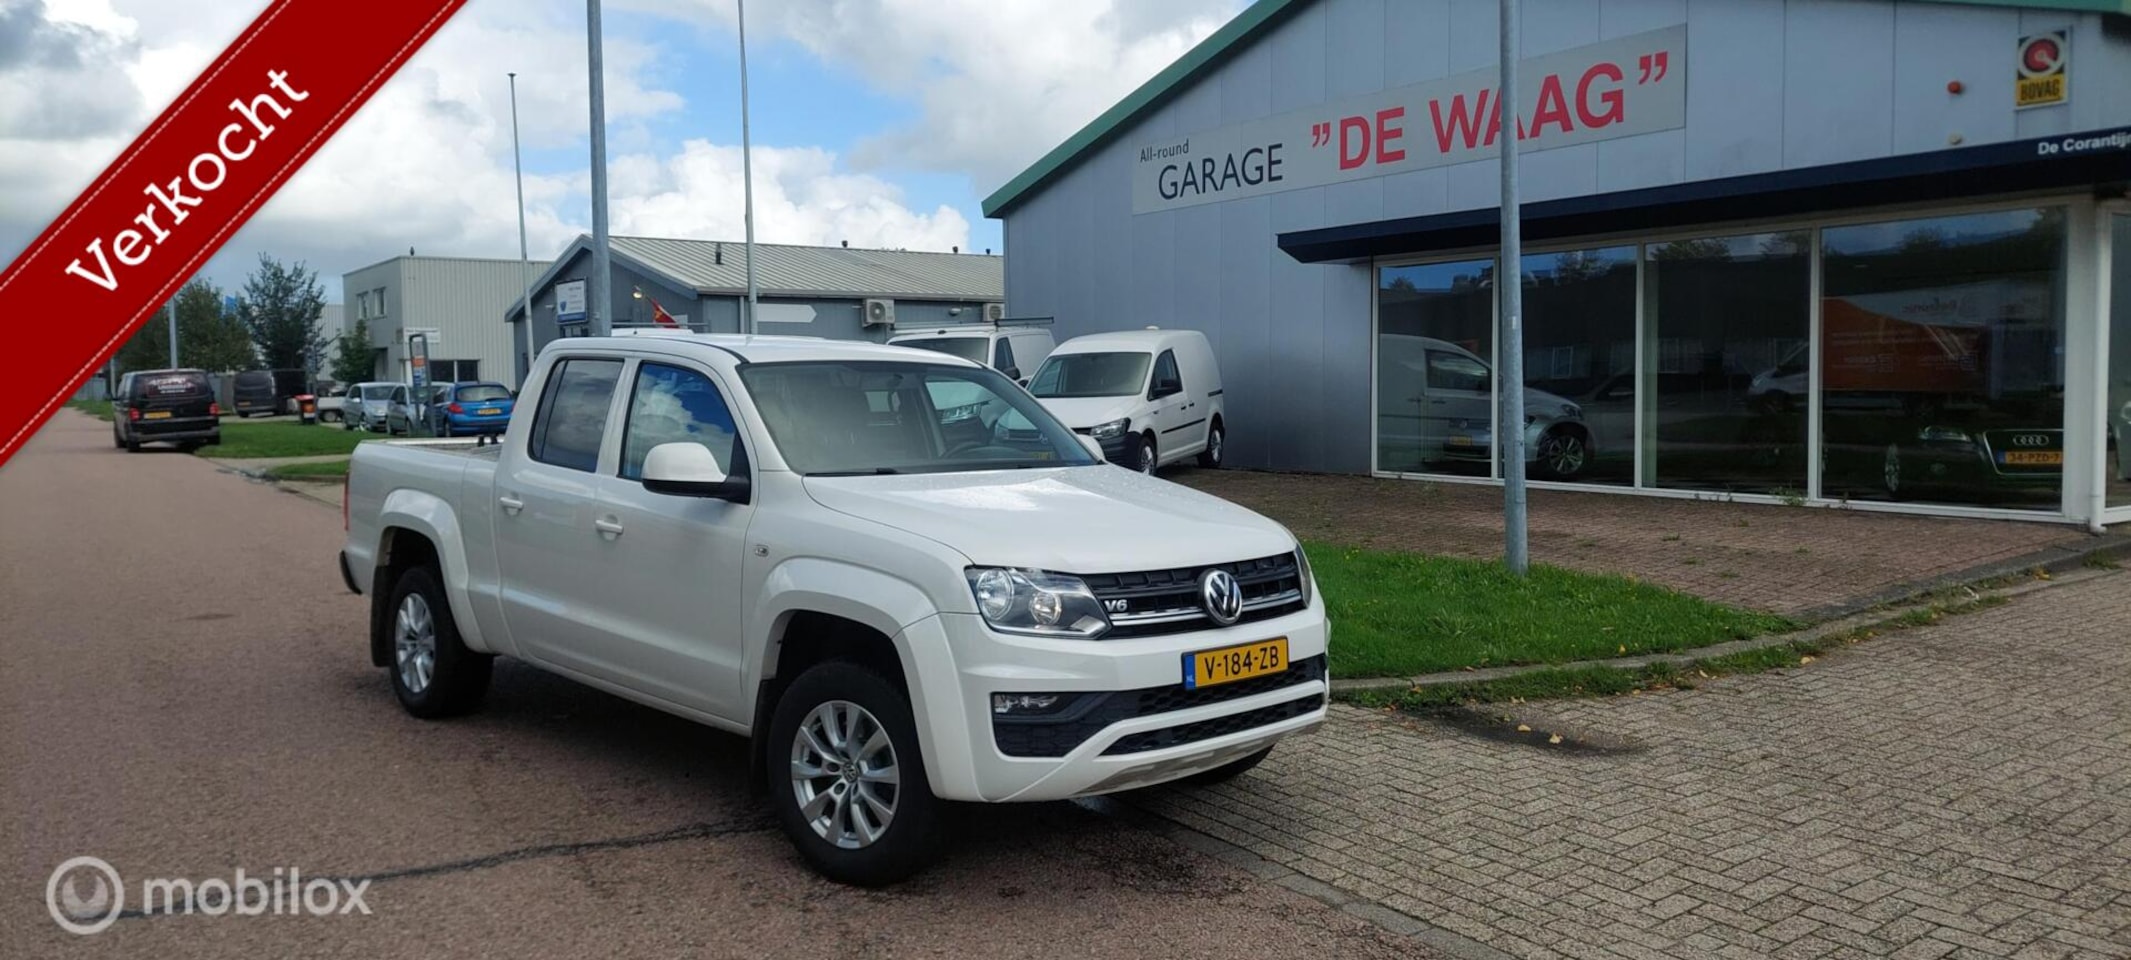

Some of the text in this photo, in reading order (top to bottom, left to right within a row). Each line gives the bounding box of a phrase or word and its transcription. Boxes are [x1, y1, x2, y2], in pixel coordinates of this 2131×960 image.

[2020, 79, 2060, 99] BOVAG
[1140, 138, 1189, 163] All-round
[2038, 142, 2059, 155] De
[1159, 143, 1283, 200] GARAGE
[1104, 599, 1128, 612] V6
[1204, 645, 1279, 679] V-184-ZB
